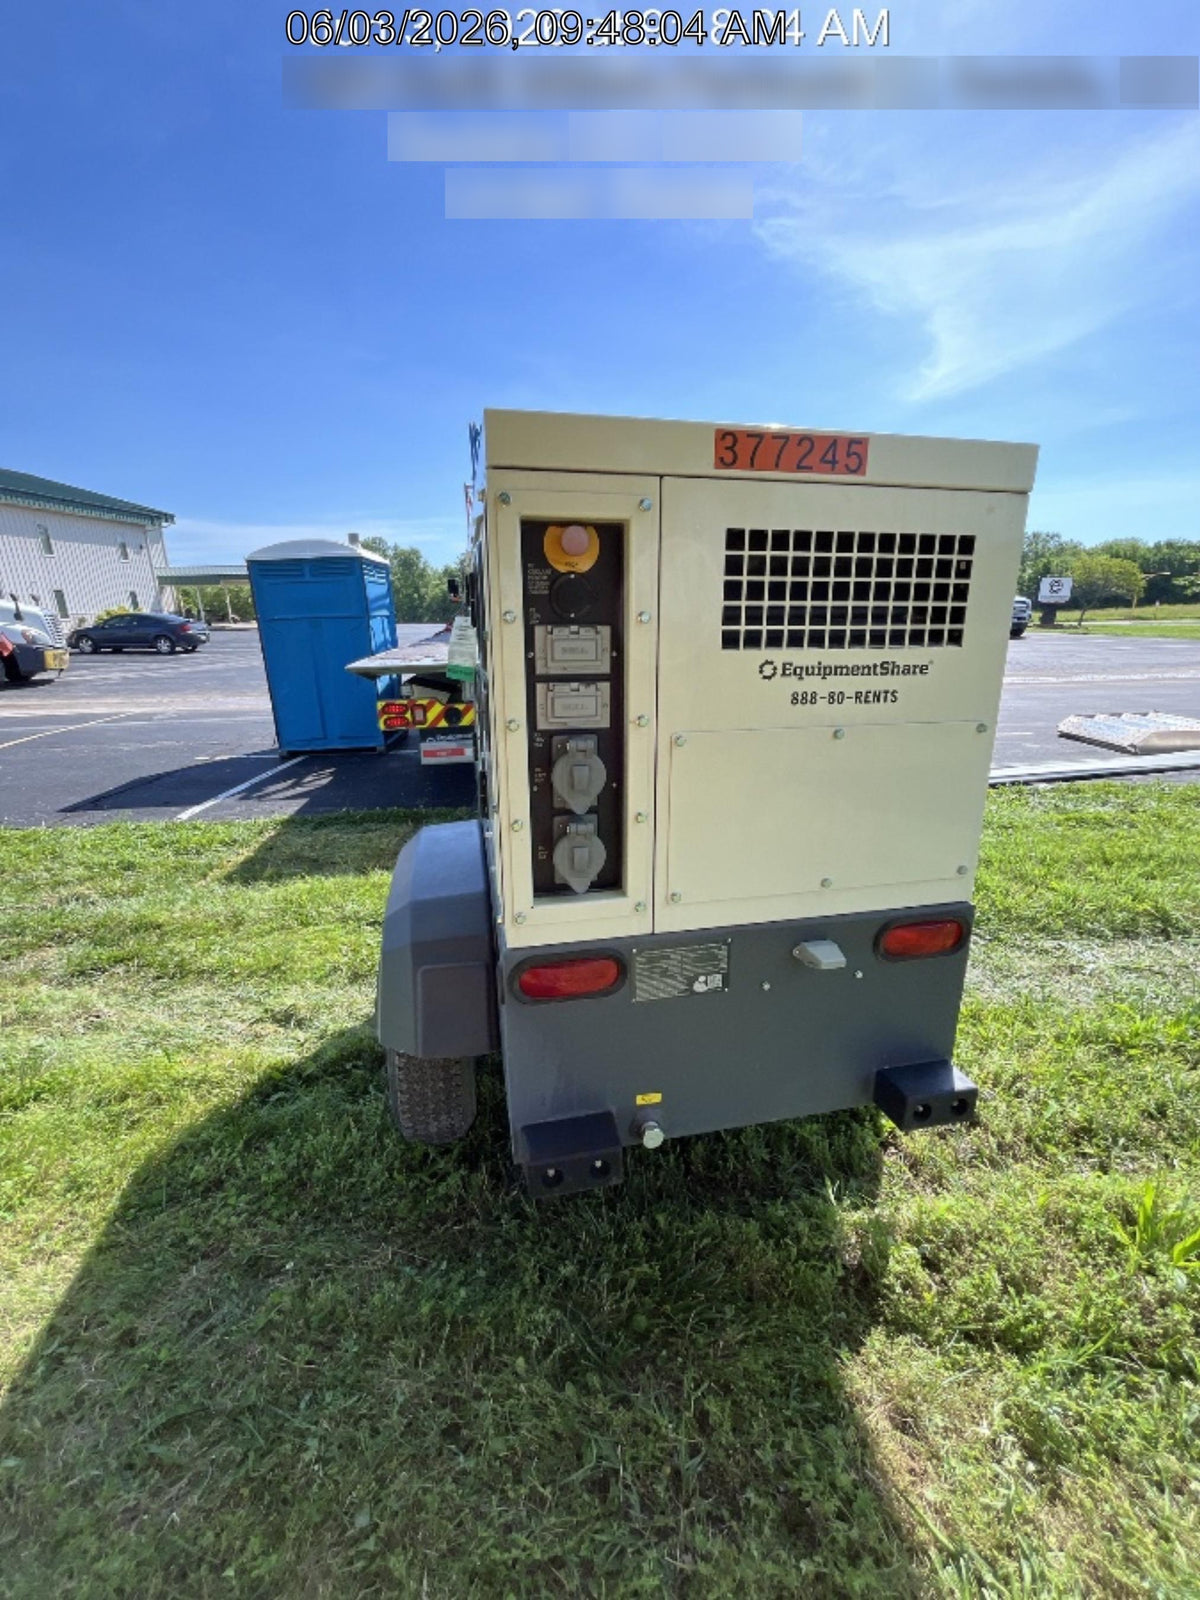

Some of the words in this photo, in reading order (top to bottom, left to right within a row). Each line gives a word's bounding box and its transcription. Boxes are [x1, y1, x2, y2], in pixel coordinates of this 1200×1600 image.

[718, 430, 864, 475] 377245
[780, 660, 929, 680] EquipmentShare
[790, 690, 899, 706] 888-80-RENTS
